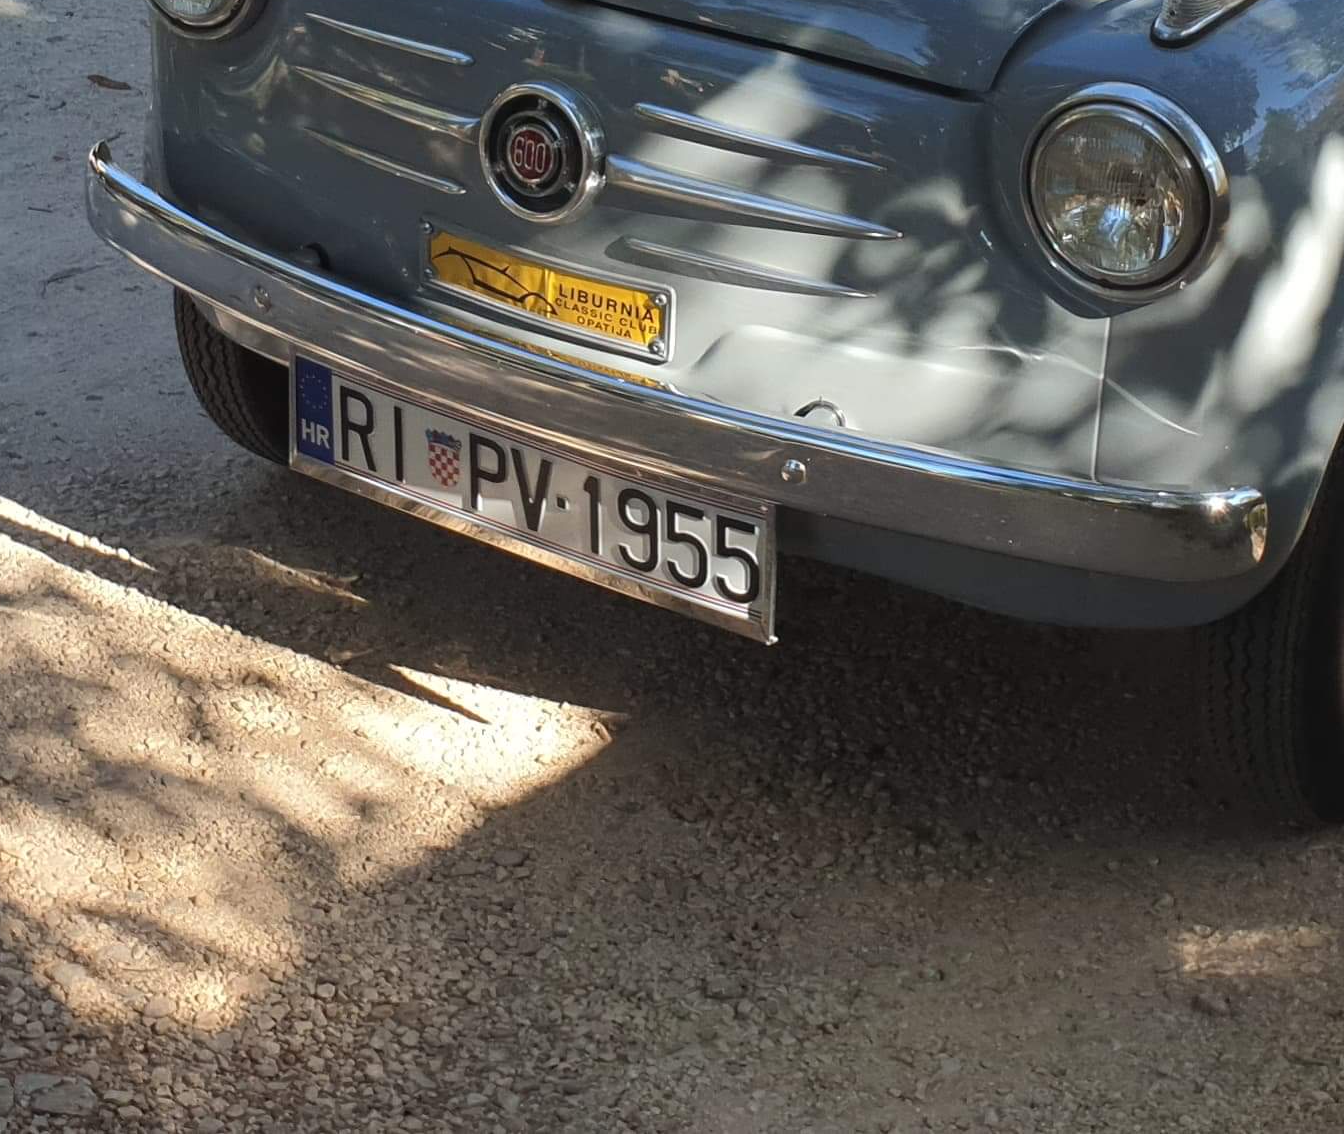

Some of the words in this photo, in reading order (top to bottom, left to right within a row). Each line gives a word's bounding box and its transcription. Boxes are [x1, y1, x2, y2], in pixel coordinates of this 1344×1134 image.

[512, 136, 547, 174] 600
[555, 297, 613, 322] CLASSIC
[619, 317, 657, 335] CLUB
[558, 283, 654, 323] LIBURNIA
[576, 316, 632, 339] OPATIJA
[300, 418, 330, 449] HR
[339, 384, 404, 482] RI
